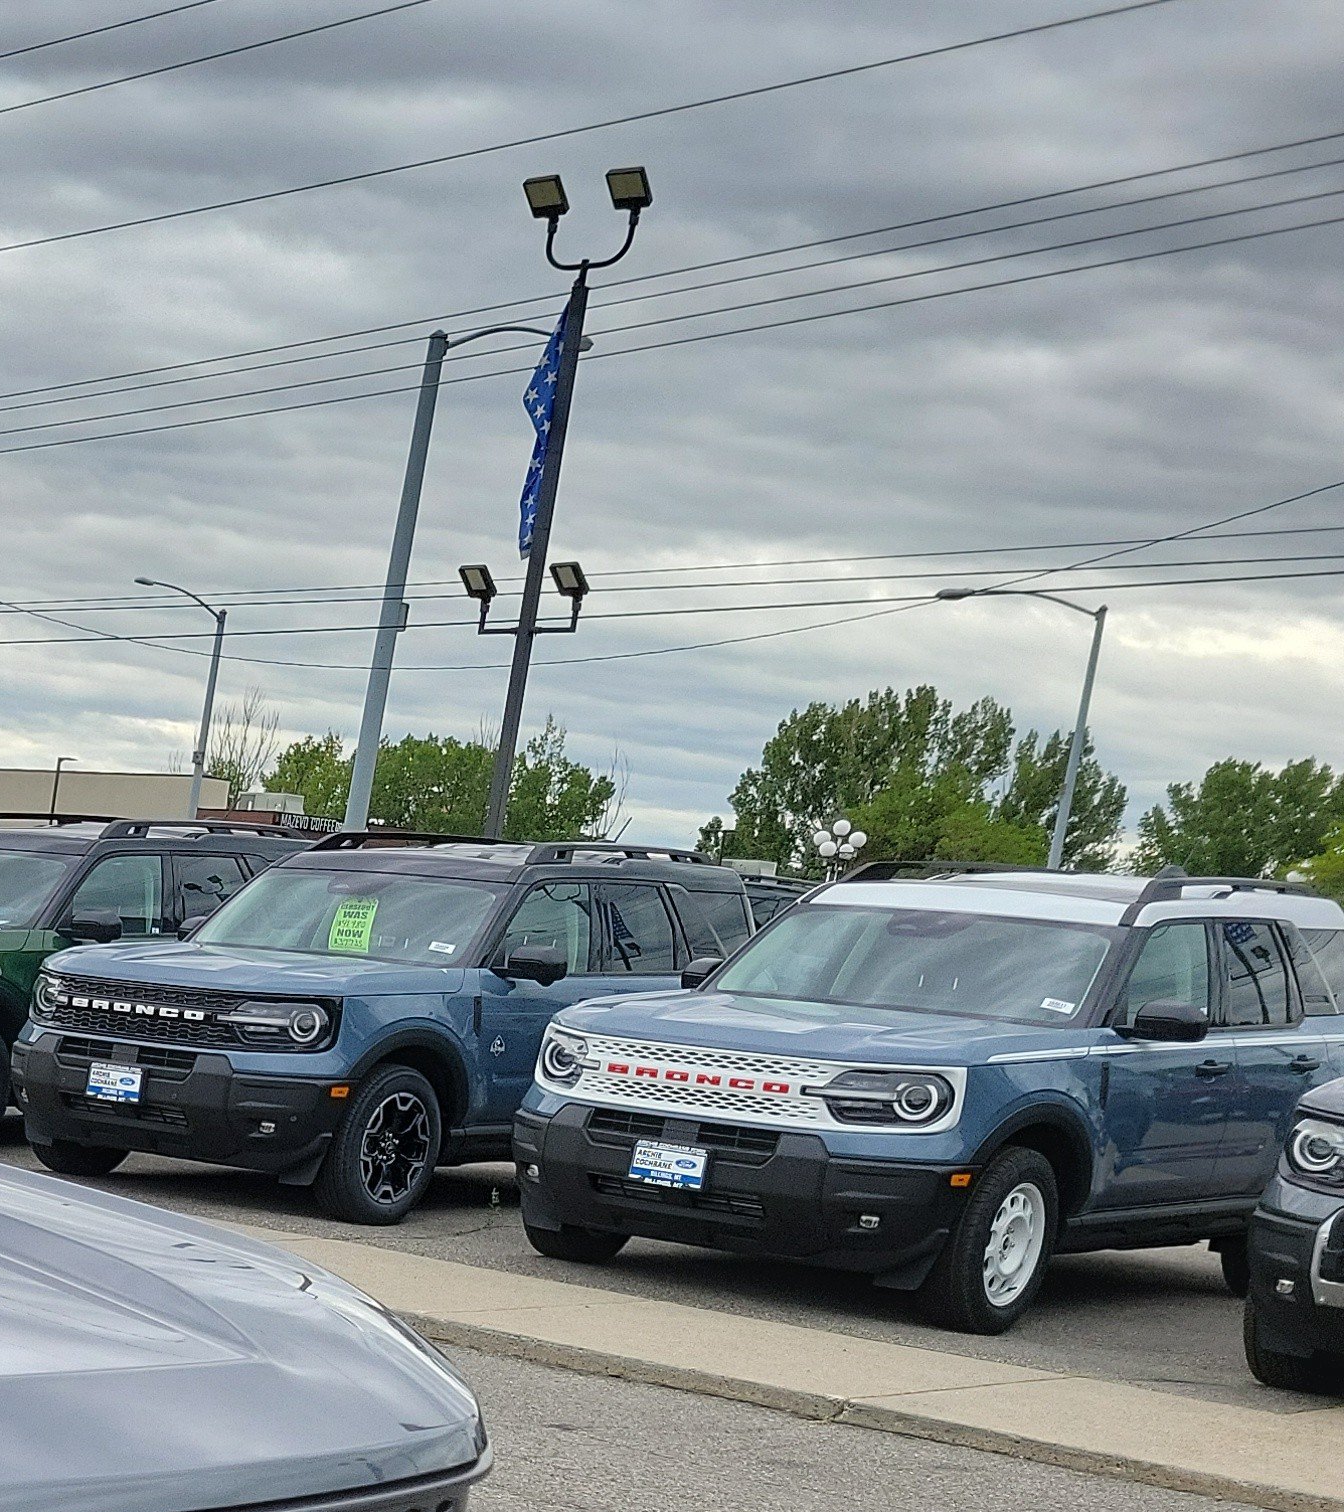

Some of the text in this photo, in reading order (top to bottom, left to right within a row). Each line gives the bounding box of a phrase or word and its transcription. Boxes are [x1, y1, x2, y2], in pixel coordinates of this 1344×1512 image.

[280, 813, 310, 830] MAZEVO
[310, 817, 335, 832] COFFEE
[343, 911, 369, 919] WAS
[337, 928, 364, 938] NOW
[72, 997, 204, 1020] BRONCO
[608, 1063, 789, 1093] BRONCO
[637, 1149, 663, 1159] ARCHIE
[635, 1158, 673, 1170] COCHRANE
